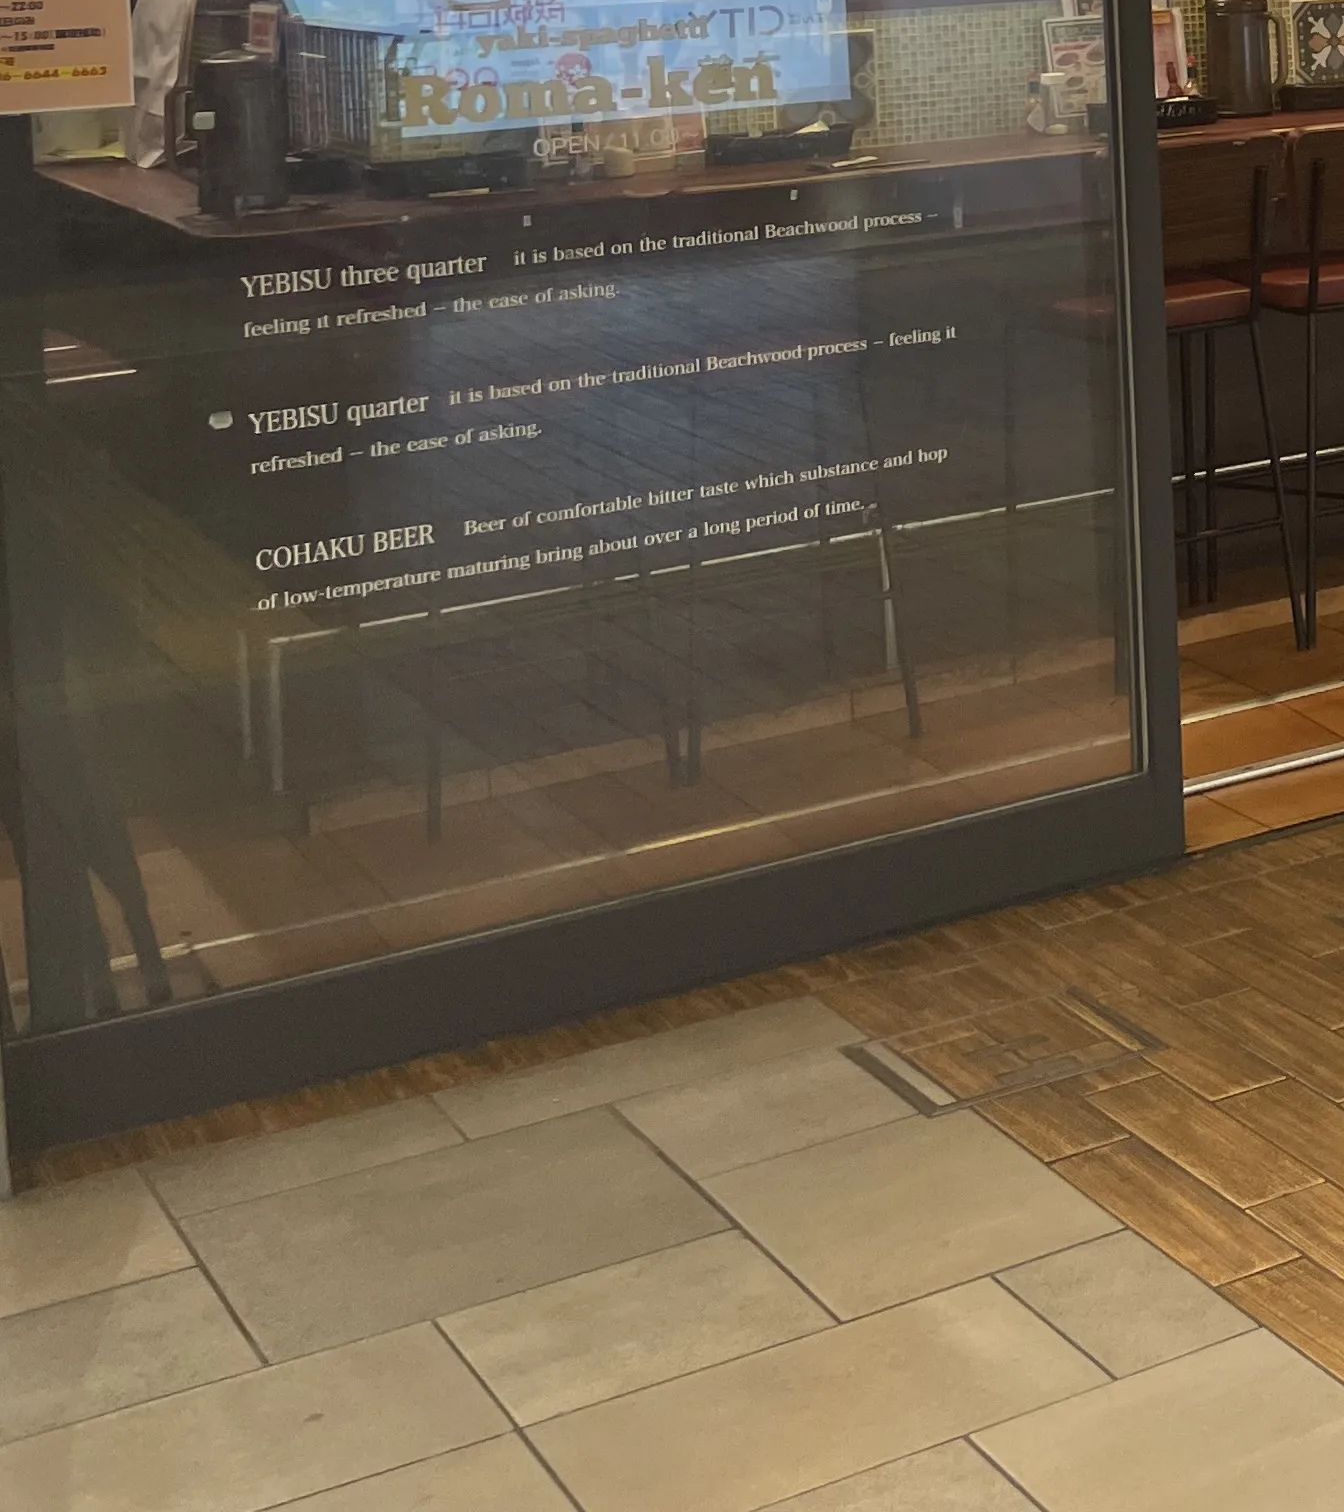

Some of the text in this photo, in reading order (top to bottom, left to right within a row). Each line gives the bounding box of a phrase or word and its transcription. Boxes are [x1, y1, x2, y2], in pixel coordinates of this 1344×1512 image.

[477, 18, 709, 58] yaki-spaghetti
[400, 54, 778, 128] Roma-ken
[532, 134, 600, 157] OPEN
[240, 209, 922, 299] YEBISU three quarter it is based on the traditional Beachwood process
[243, 315, 311, 339] feeling
[316, 313, 330, 330] it
[336, 301, 427, 328] refreshed
[452, 296, 483, 314] the
[534, 287, 553, 304] of
[558, 281, 621, 302] asking.
[248, 325, 957, 435] YEBISU quarter it is based on the traditional Beachwood process feeling it
[251, 447, 343, 475] refreshed
[369, 441, 401, 458] the
[454, 428, 474, 445] of
[478, 420, 542, 442] asking.
[255, 446, 949, 572] COHAKU BEER Beer of comfortable bitter taste which substance and hop
[257, 498, 866, 612] of low-temperature maturing bring about over a long period of time.
